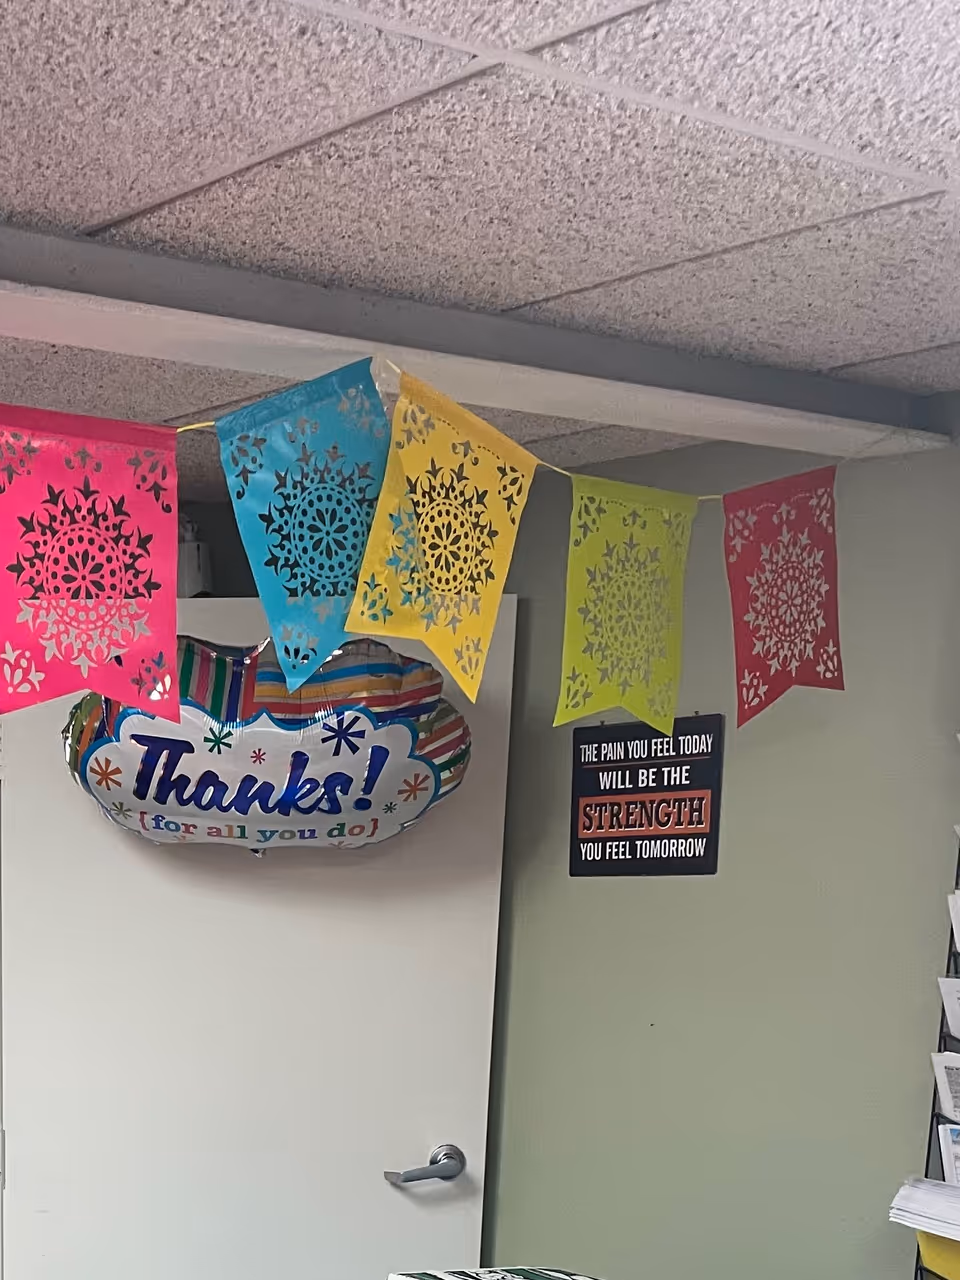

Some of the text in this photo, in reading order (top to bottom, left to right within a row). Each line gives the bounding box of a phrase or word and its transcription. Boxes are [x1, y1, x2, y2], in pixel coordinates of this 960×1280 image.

[580, 733, 713, 763] THE PAIN YOU FEEL TODAY
[130, 734, 390, 817] Thanks!
[599, 765, 691, 790] WILL BE THE
[582, 797, 707, 833] STRENGTH
[207, 821, 248, 840] all
[257, 827, 318, 842] you
[580, 838, 707, 861] YOU FEEL TOMORROW
